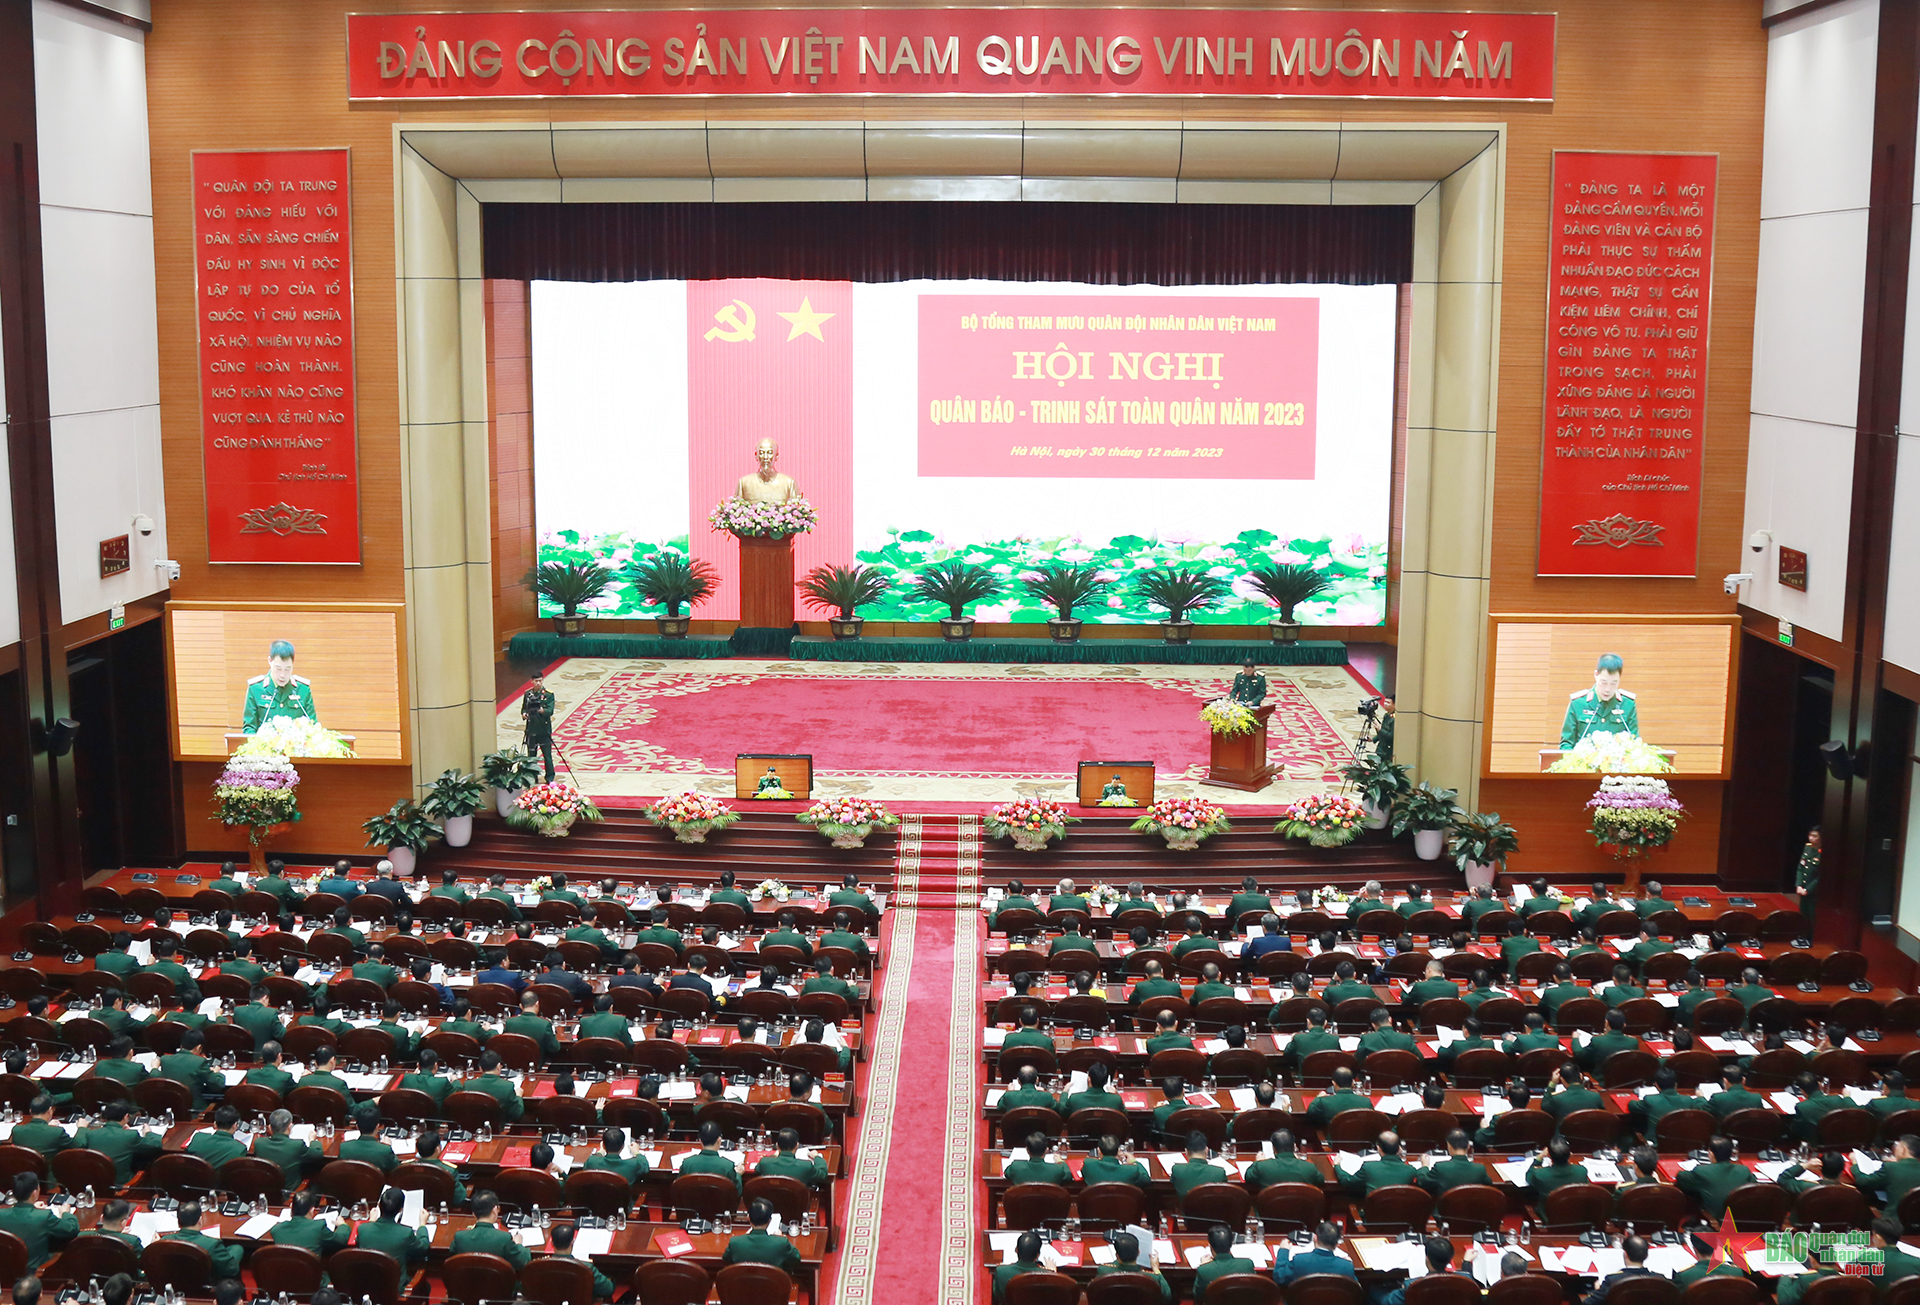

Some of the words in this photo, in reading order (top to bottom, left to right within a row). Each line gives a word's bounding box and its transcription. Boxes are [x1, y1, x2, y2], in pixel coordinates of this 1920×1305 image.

[377, 26, 501, 78] ĐẢNG
[516, 29, 650, 85] CỘNG
[663, 23, 747, 77] SẢN
[760, 28, 844, 84] VIỆT
[858, 36, 959, 75] NAM
[976, 35, 1141, 77] QUANG
[1153, 37, 1252, 76] VINH
[1271, 29, 1400, 77] MUÔN
[1414, 30, 1512, 79] NĂM
[254, 179, 273, 194] ĐỘI
[280, 181, 294, 191] TA
[300, 180, 337, 191] TRUNG
[1580, 180, 1618, 195] ĐẢNG
[1628, 185, 1642, 195] TA
[1653, 182, 1667, 195] LÀ
[1679, 184, 1705, 198] MỘT
[204, 205, 225, 218] VỚI
[236, 205, 272, 218] ĐẢNG
[282, 204, 306, 217] HIẾU
[317, 204, 337, 216] VỚI
[1564, 201, 1600, 215] ĐẢNG
[1603, 201, 1632, 216] CẦM
[1680, 202, 1703, 217] MỖI
[239, 229, 261, 244] SẴN
[266, 231, 299, 244] SÀNG
[304, 229, 338, 243] CHIẾN
[1563, 221, 1600, 235] ĐẢNG
[1604, 223, 1630, 235] VIÊN
[1635, 223, 1650, 236] VÀ
[1655, 223, 1681, 237] CÁN
[1686, 224, 1702, 238] BỘ
[1563, 242, 1590, 255] PHẢI
[1601, 246, 1633, 258] THỰC
[1643, 247, 1658, 259] SỰ
[1668, 243, 1701, 258] THẤM
[207, 257, 230, 269] ĐẤU
[238, 260, 252, 269] HY
[261, 259, 285, 269] SINH
[293, 257, 304, 269] VÌ
[313, 257, 339, 271] ĐỘC
[1561, 262, 1603, 276] NHUẦN
[1606, 266, 1633, 278] ĐẠO
[1637, 265, 1662, 277] ĐỨC
[1664, 265, 1699, 278] CÁCH
[208, 284, 229, 297] LẬP
[238, 286, 251, 297] TỰ
[262, 285, 279, 295] DO
[289, 283, 315, 295] CỦA
[325, 280, 340, 295] TỔ
[1611, 285, 1639, 299] THẬT
[1649, 287, 1663, 299] SỰ
[1672, 284, 1698, 298] CẦN
[254, 308, 265, 320] VÌ
[272, 307, 296, 321] CHỦ
[304, 308, 341, 320] NGHĨA
[1560, 304, 1588, 319] KIỆM
[1595, 304, 1620, 317] LIÊM
[1677, 305, 1698, 318] CHÍ
[962, 314, 978, 332] BỘ
[982, 311, 1014, 329] TỔNG
[1018, 317, 1052, 329] THAM
[1056, 316, 1085, 330] MƯU
[1088, 315, 1122, 331] QUÂN
[1125, 315, 1146, 333] ĐỘI
[1150, 315, 1184, 331] NHÂN
[1188, 315, 1214, 331] DÂN
[1217, 316, 1244, 333] VIỆT
[1247, 318, 1275, 331] NAM
[1559, 324, 1597, 337] CÔNG
[1603, 325, 1620, 337] VÔ
[1645, 325, 1672, 338] PHẢI
[1676, 326, 1698, 339] GIỮ
[210, 335, 226, 347] XÃ
[257, 335, 292, 348] NHIỆM
[296, 337, 311, 348] VỤ
[315, 333, 341, 346] NÀO
[1559, 344, 1582, 357] GÌN
[1593, 344, 1631, 357] ĐẢNG
[1643, 348, 1656, 358] TA
[1668, 347, 1697, 360] THẬT
[211, 360, 245, 372] CŨNG
[256, 359, 290, 372] HOÀN
[1012, 342, 1094, 387] HỘI
[1109, 352, 1224, 389] NGHỊ
[1559, 367, 1604, 377] TRONG
[1666, 365, 1696, 378] PHẢI
[212, 385, 236, 398] KHÓ
[278, 385, 304, 398] NÀO
[309, 385, 343, 397] CŨNG
[1558, 384, 1592, 398] XỨNG
[1597, 384, 1633, 398] ĐÁNG
[1638, 386, 1650, 398] LÀ
[1656, 386, 1695, 399] NGƯỜI
[213, 413, 242, 425] VƯỢT
[278, 410, 290, 423] KẺ
[294, 410, 314, 423] THÙ
[318, 410, 344, 423] NÀO
[930, 396, 975, 425] QUÂN
[981, 396, 1014, 423] BÁO
[1031, 401, 1080, 423] TRINH
[1085, 397, 1116, 424] SÁT
[1121, 397, 1165, 425] TOÀN
[1170, 397, 1215, 427] QUÂN
[1221, 397, 1259, 425] NĂM
[1264, 403, 1304, 426] 2023
[1557, 405, 1587, 418] LÃNH
[1630, 405, 1644, 418] LÀ
[1652, 406, 1691, 419] NGƯỜI
[1557, 423, 1581, 437] ĐẦY
[1591, 425, 1605, 438] TỚ
[1613, 426, 1643, 440] THẬT
[1650, 428, 1692, 438] TRUNG
[214, 436, 248, 449] CŨNG
[251, 436, 282, 448] ĐÁNH
[1010, 446, 1026, 456] Hà
[1030, 446, 1054, 459] Nội,
[1057, 446, 1086, 458] ngày
[1089, 447, 1104, 457] 30
[1108, 446, 1142, 459] tháng
[1147, 447, 1161, 457] 12
[1164, 448, 1190, 457] năm
[1192, 448, 1223, 458] 2023
[1556, 444, 1594, 457] THÀNH
[1597, 444, 1621, 458] CỦA
[1624, 446, 1658, 459] NHÂN
[112, 618, 124, 629] EXIT
